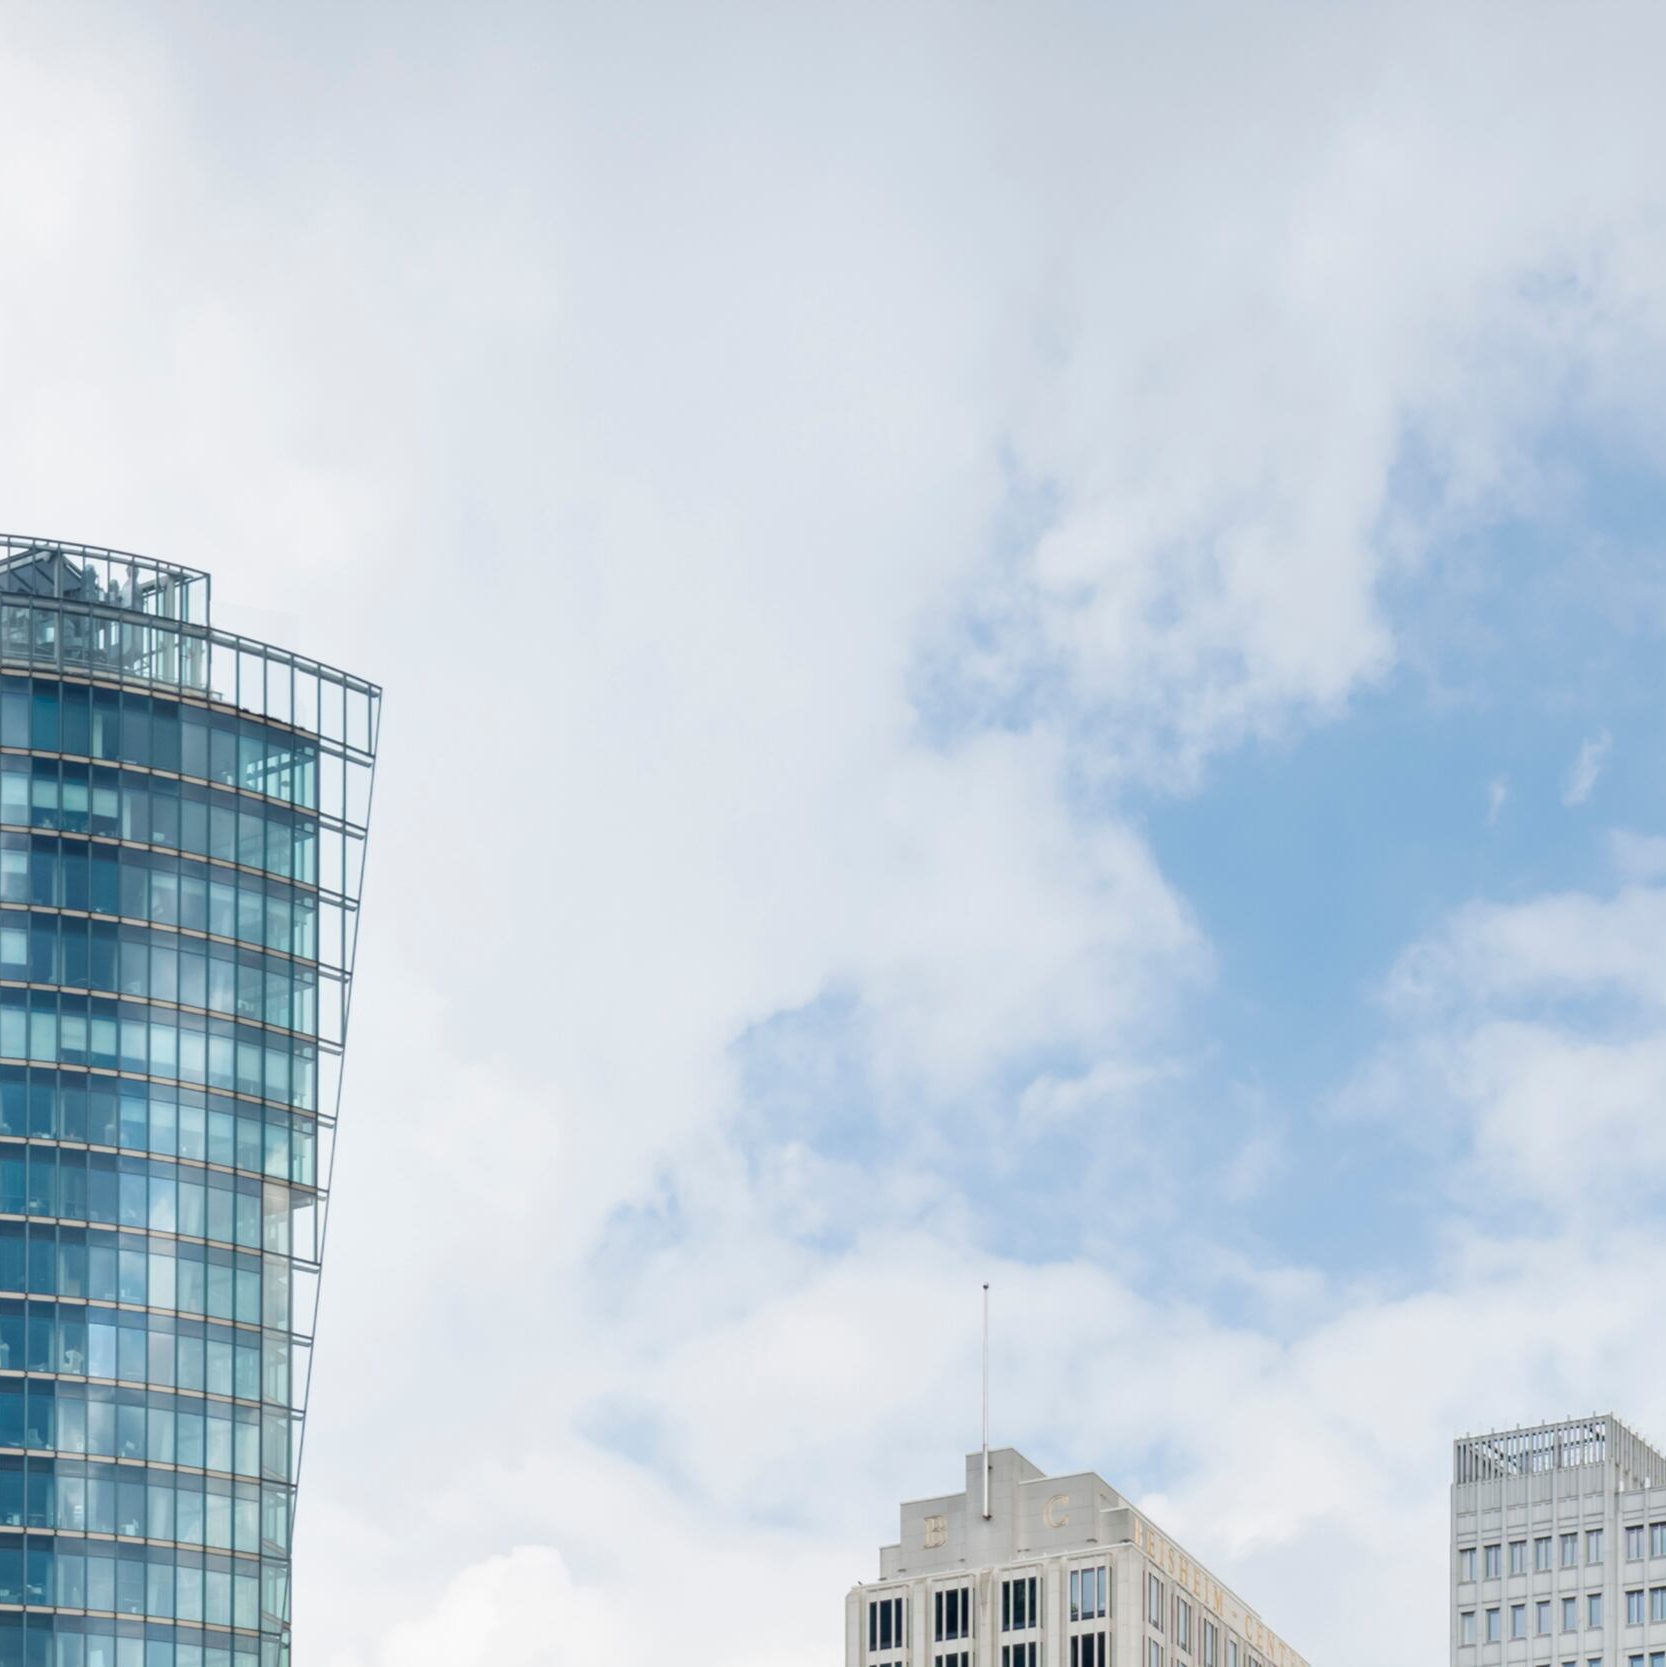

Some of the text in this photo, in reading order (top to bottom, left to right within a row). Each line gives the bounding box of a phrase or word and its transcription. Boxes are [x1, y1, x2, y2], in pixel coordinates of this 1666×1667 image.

[923, 1494, 1071, 1550] B C
[1135, 1518, 1225, 1617] BEISHEIM
